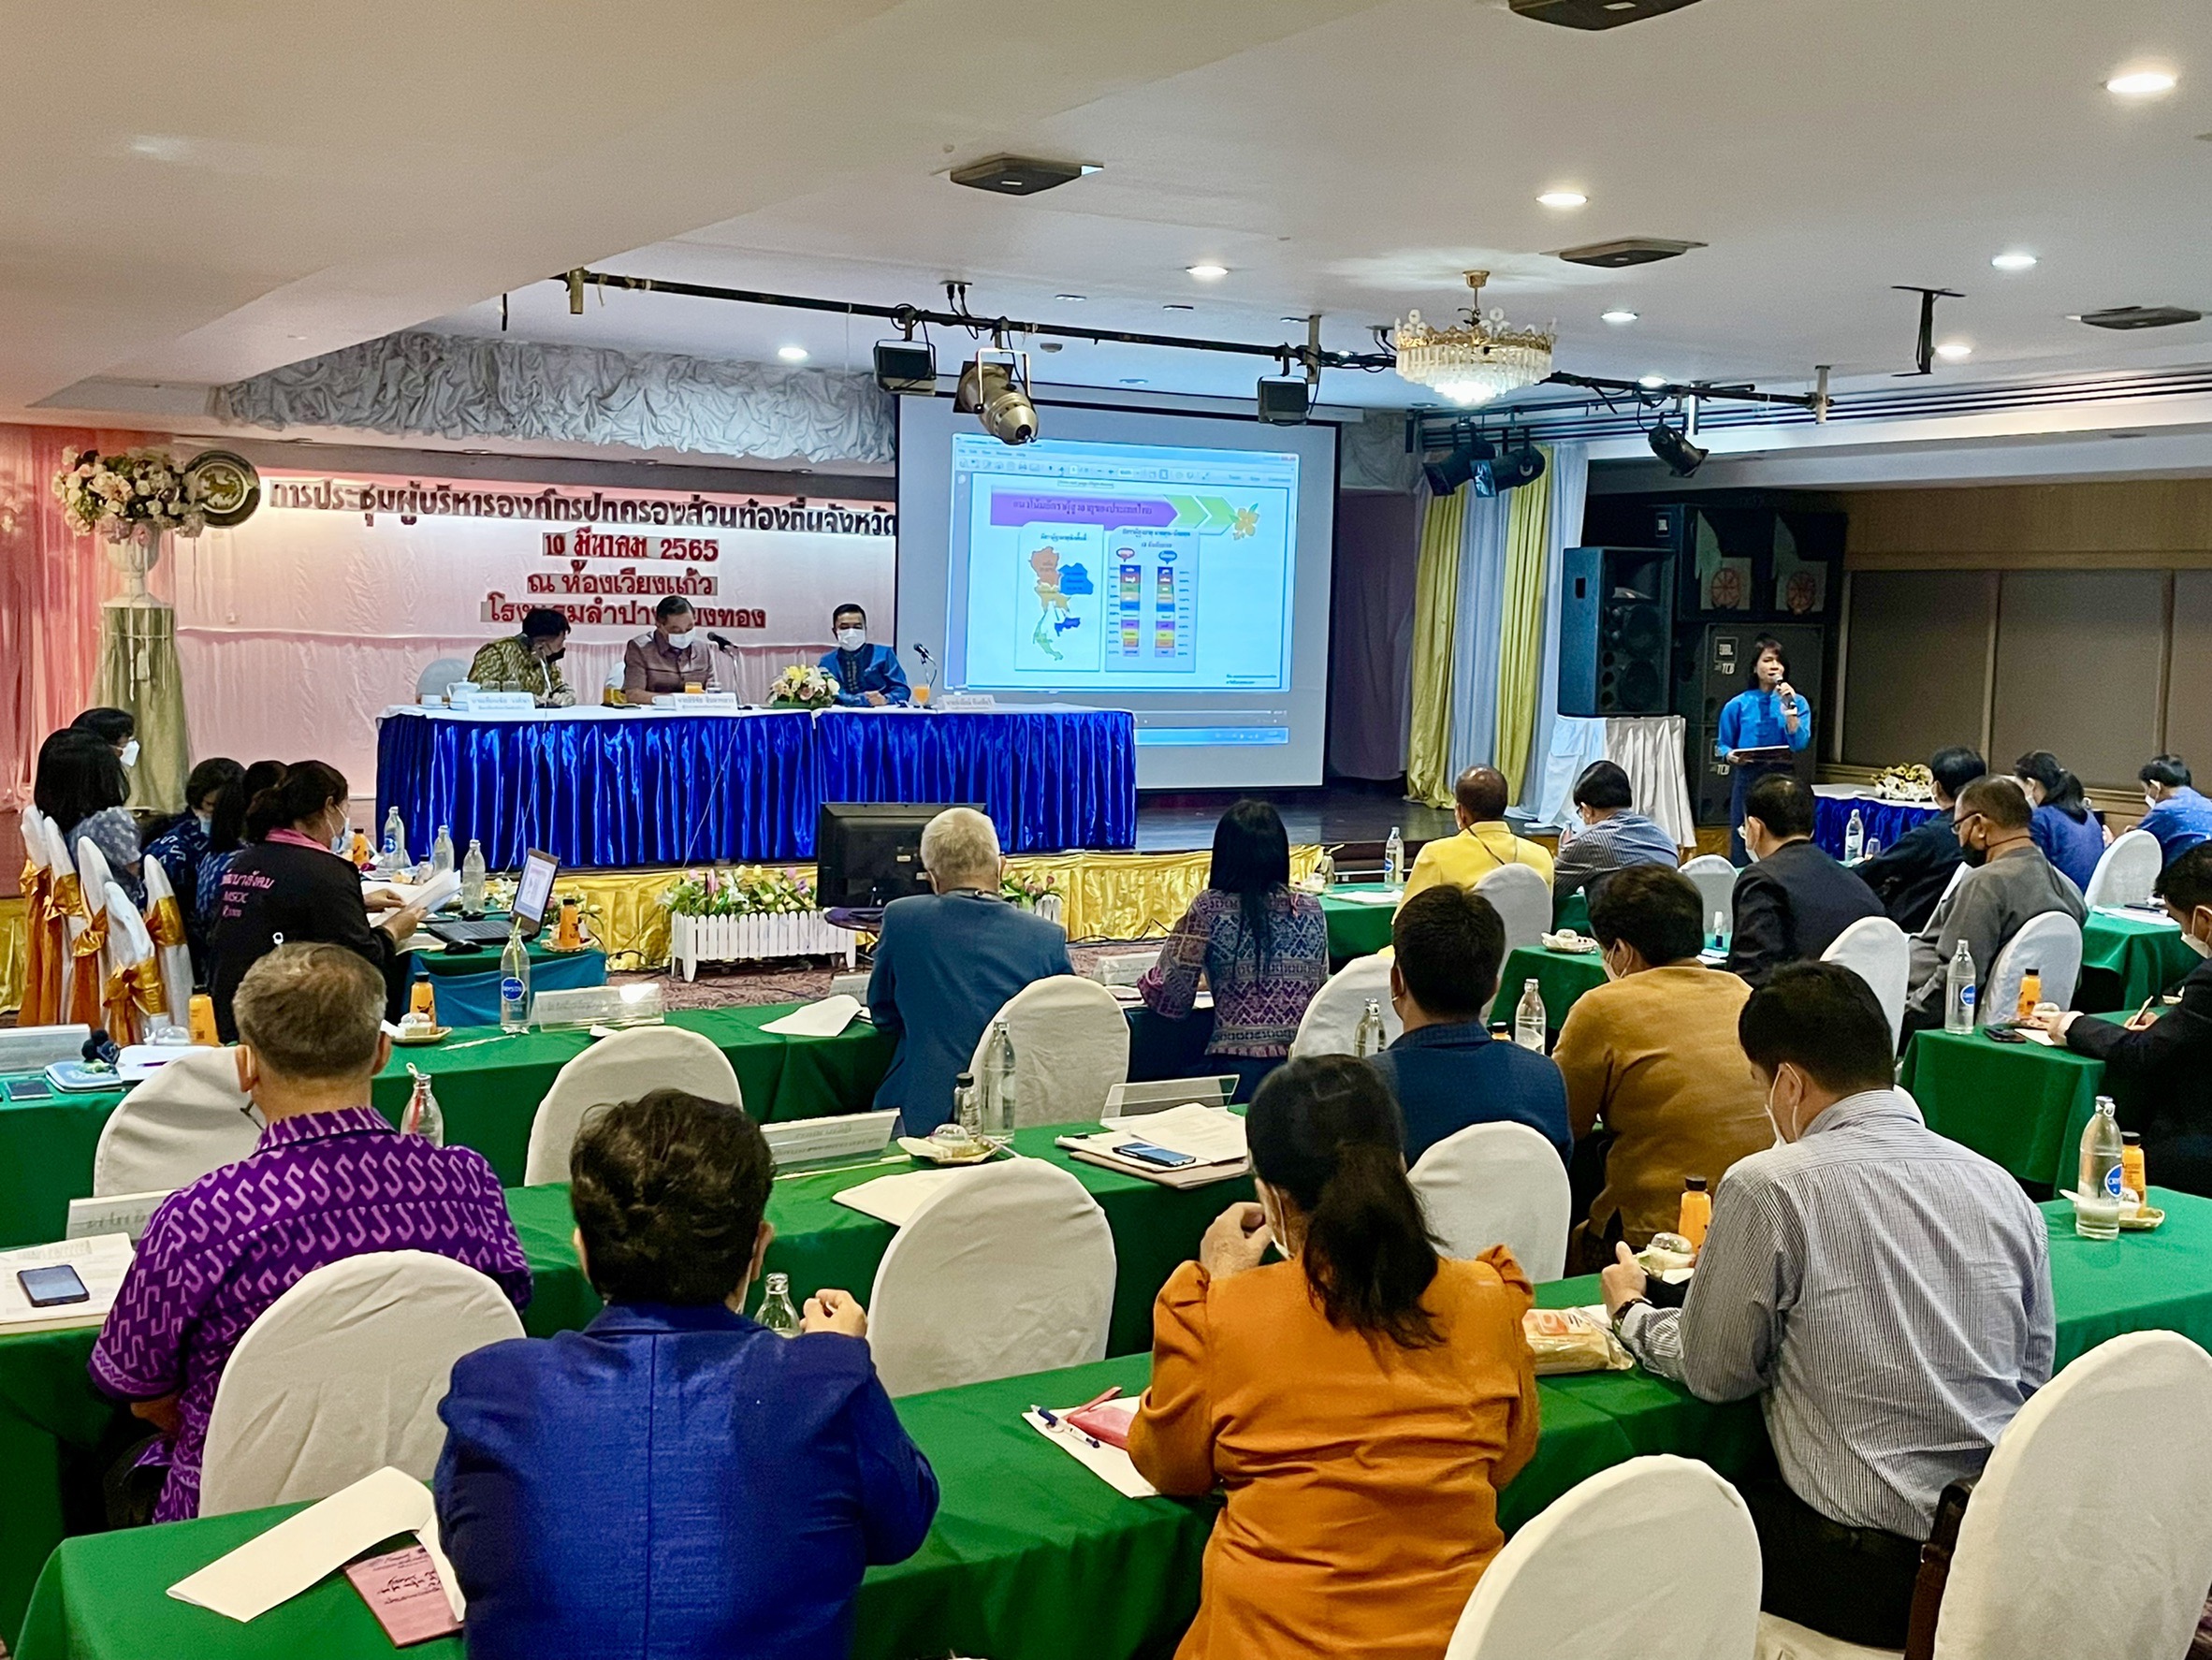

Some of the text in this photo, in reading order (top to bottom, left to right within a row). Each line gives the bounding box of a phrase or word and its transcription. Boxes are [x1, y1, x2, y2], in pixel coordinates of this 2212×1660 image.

[546, 525, 719, 561] 10 มีนาคม 2565
[529, 560, 713, 595] ณ ห้องเวียงแก้ว
